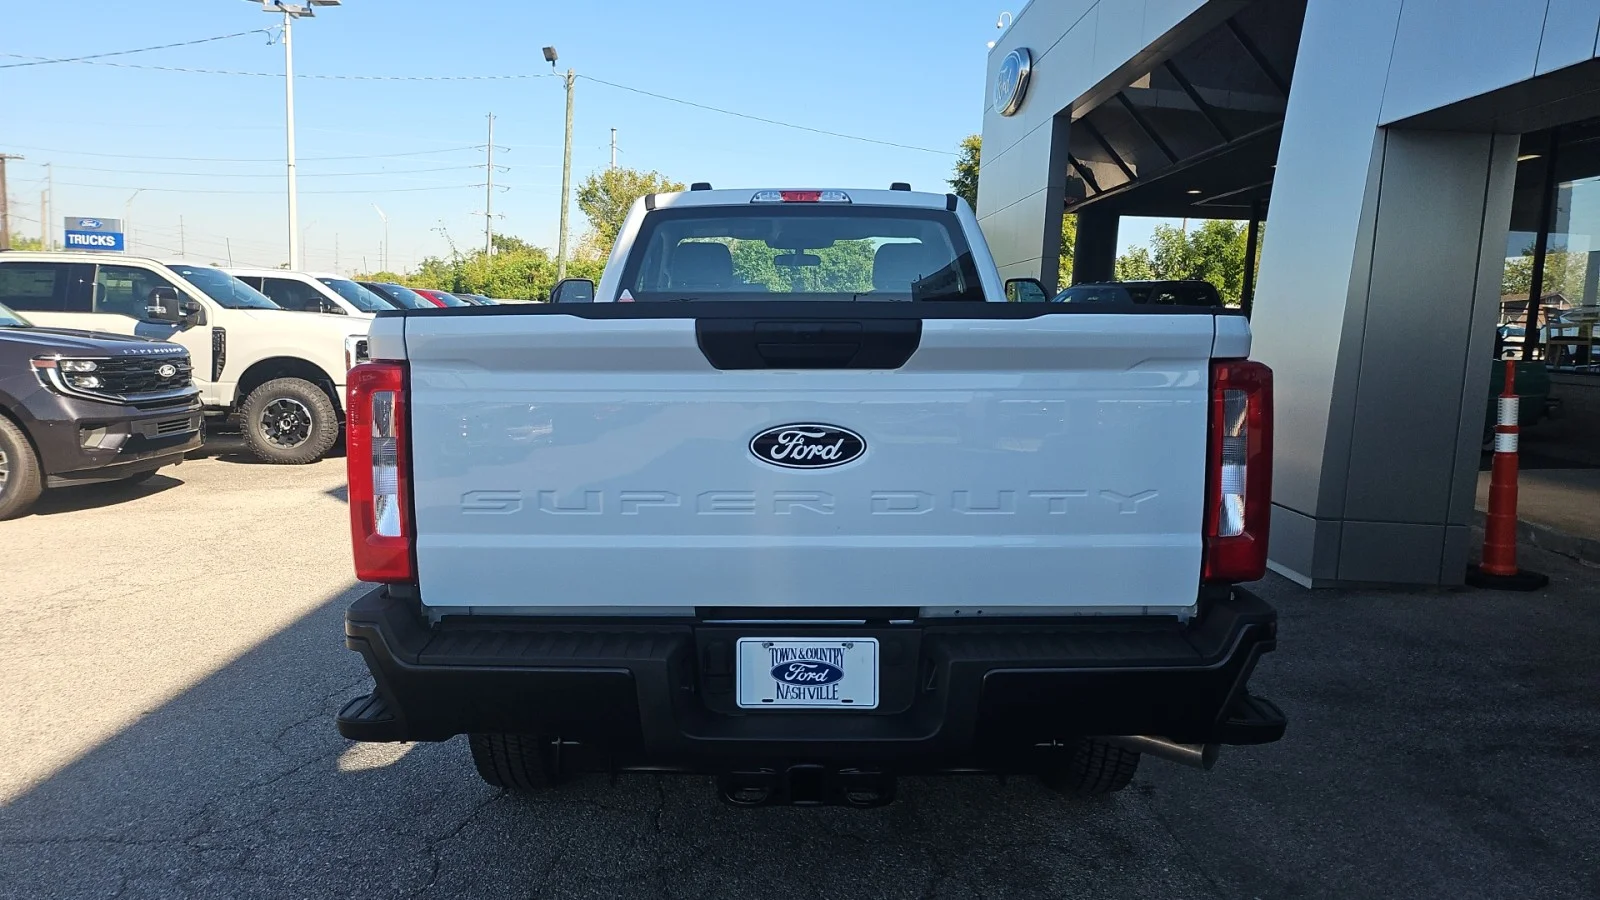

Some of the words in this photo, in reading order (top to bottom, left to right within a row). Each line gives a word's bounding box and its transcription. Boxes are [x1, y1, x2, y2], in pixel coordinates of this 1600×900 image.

[67, 233, 116, 246] TRUCKS
[770, 430, 845, 460] Ford
[461, 489, 835, 515] SUPER
[871, 489, 1159, 515] DUTY
[768, 647, 797, 667] TOWN
[806, 647, 846, 669] COUNTRY
[784, 662, 830, 682] Ford
[775, 681, 839, 701] NASHVILLE
